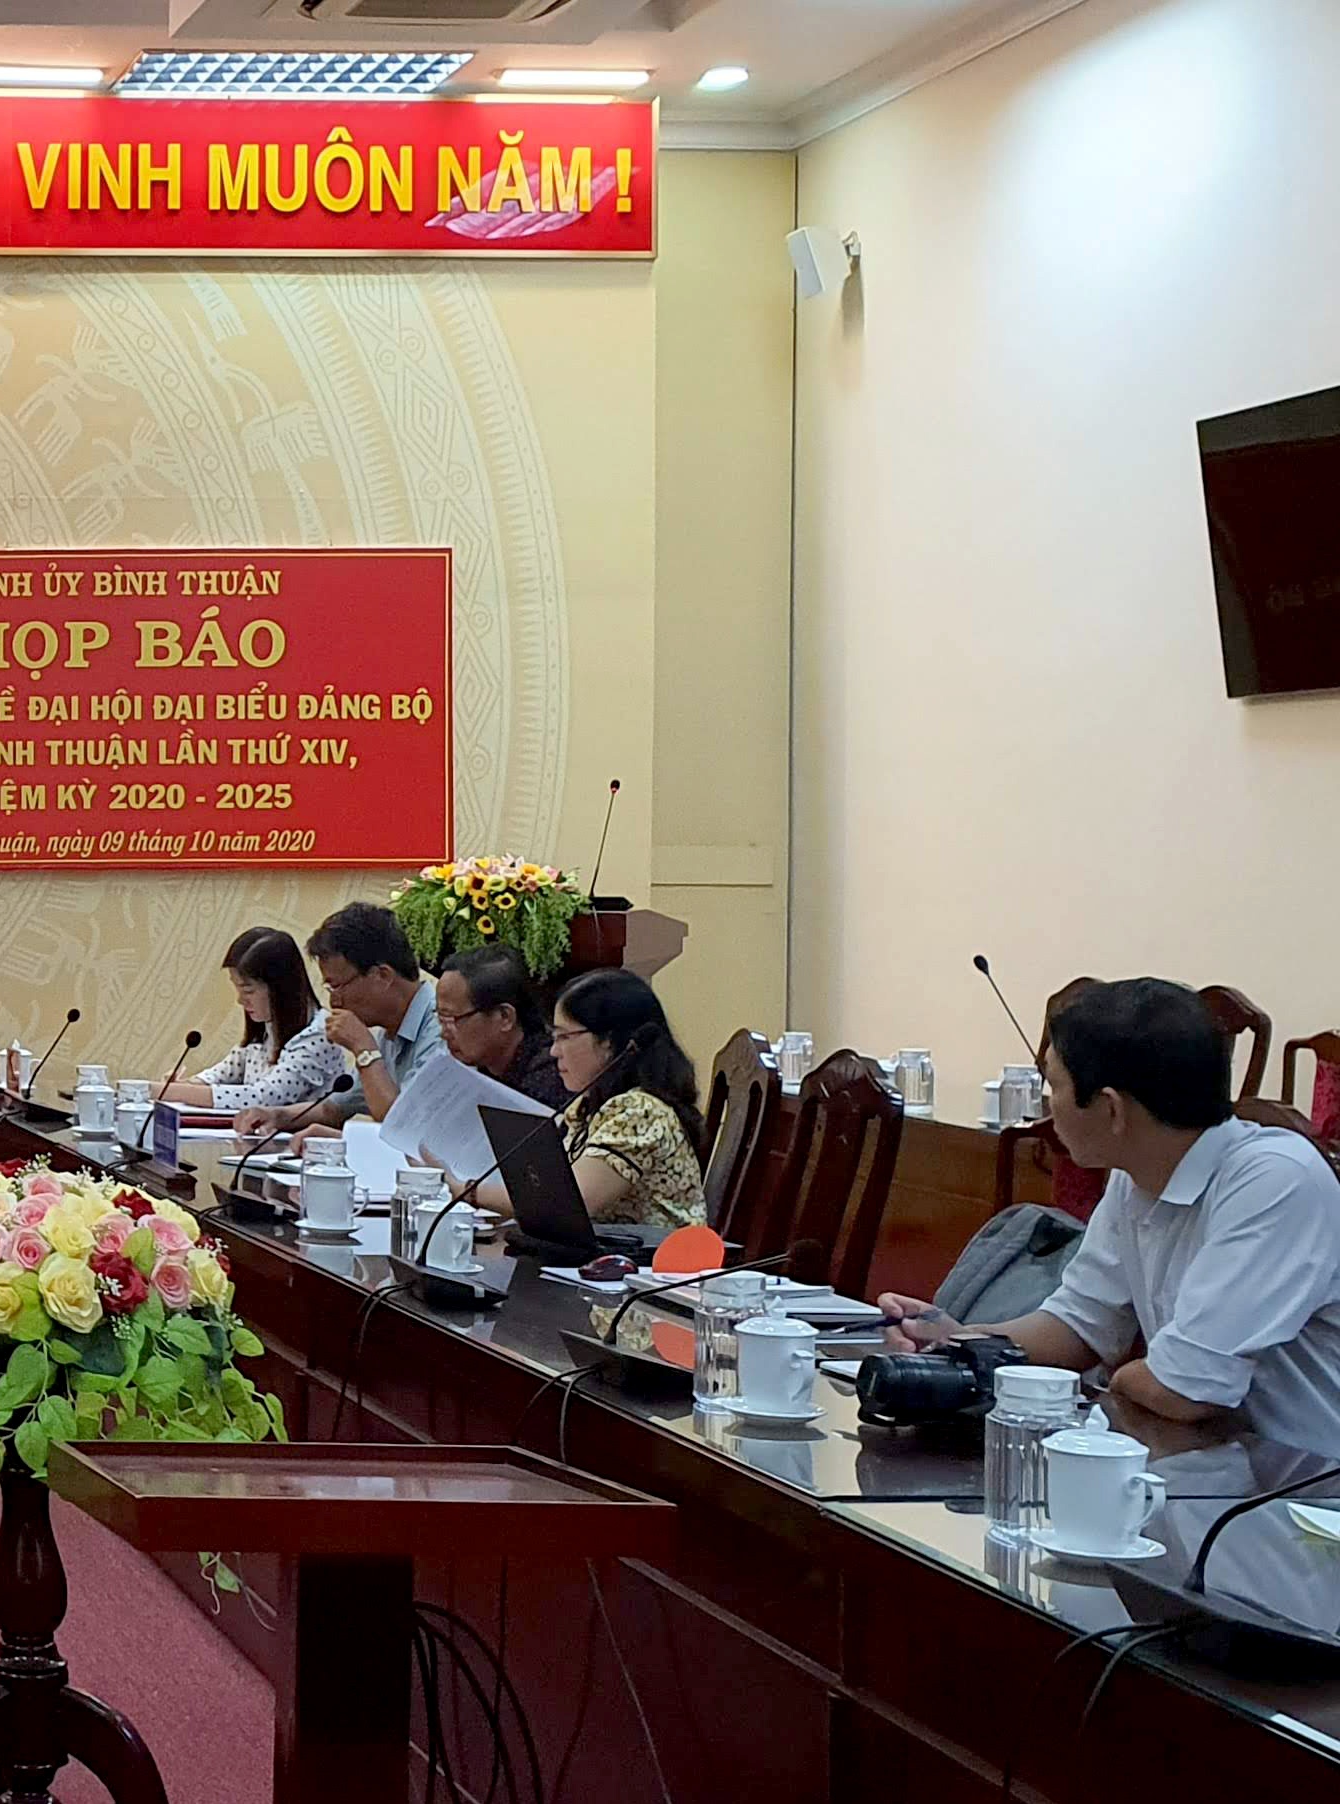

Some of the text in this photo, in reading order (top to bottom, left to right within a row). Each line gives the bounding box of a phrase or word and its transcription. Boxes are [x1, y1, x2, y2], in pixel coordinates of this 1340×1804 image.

[16, 142, 182, 211] VINH
[206, 126, 412, 214] MUÔN
[436, 129, 594, 215] NĂM
[614, 147, 633, 214] !
[42, 562, 84, 597] ỦY
[93, 564, 168, 596] BÌNH
[176, 563, 282, 601] THUẬN
[135, 605, 286, 668] BÁO
[27, 695, 79, 726] ĐẠI
[90, 688, 142, 726] HỘI
[152, 694, 205, 725] ĐẠI
[216, 681, 287, 720] BIỂU
[297, 684, 381, 720] ĐẢNG
[391, 687, 433, 725] BỘ
[44, 733, 148, 770] THUẬN
[158, 728, 218, 765] LẦN
[226, 732, 292, 765] THỨ
[299, 738, 358, 769] XIV,
[57, 778, 97, 810] KỲ
[108, 783, 185, 810] 2020
[216, 783, 293, 809] 2025
[46, 829, 96, 858] ngày
[99, 830, 125, 853] 09
[128, 829, 186, 857] tháng
[190, 830, 216, 852] 10
[218, 830, 261, 852] năm
[264, 830, 316, 852] 2020
